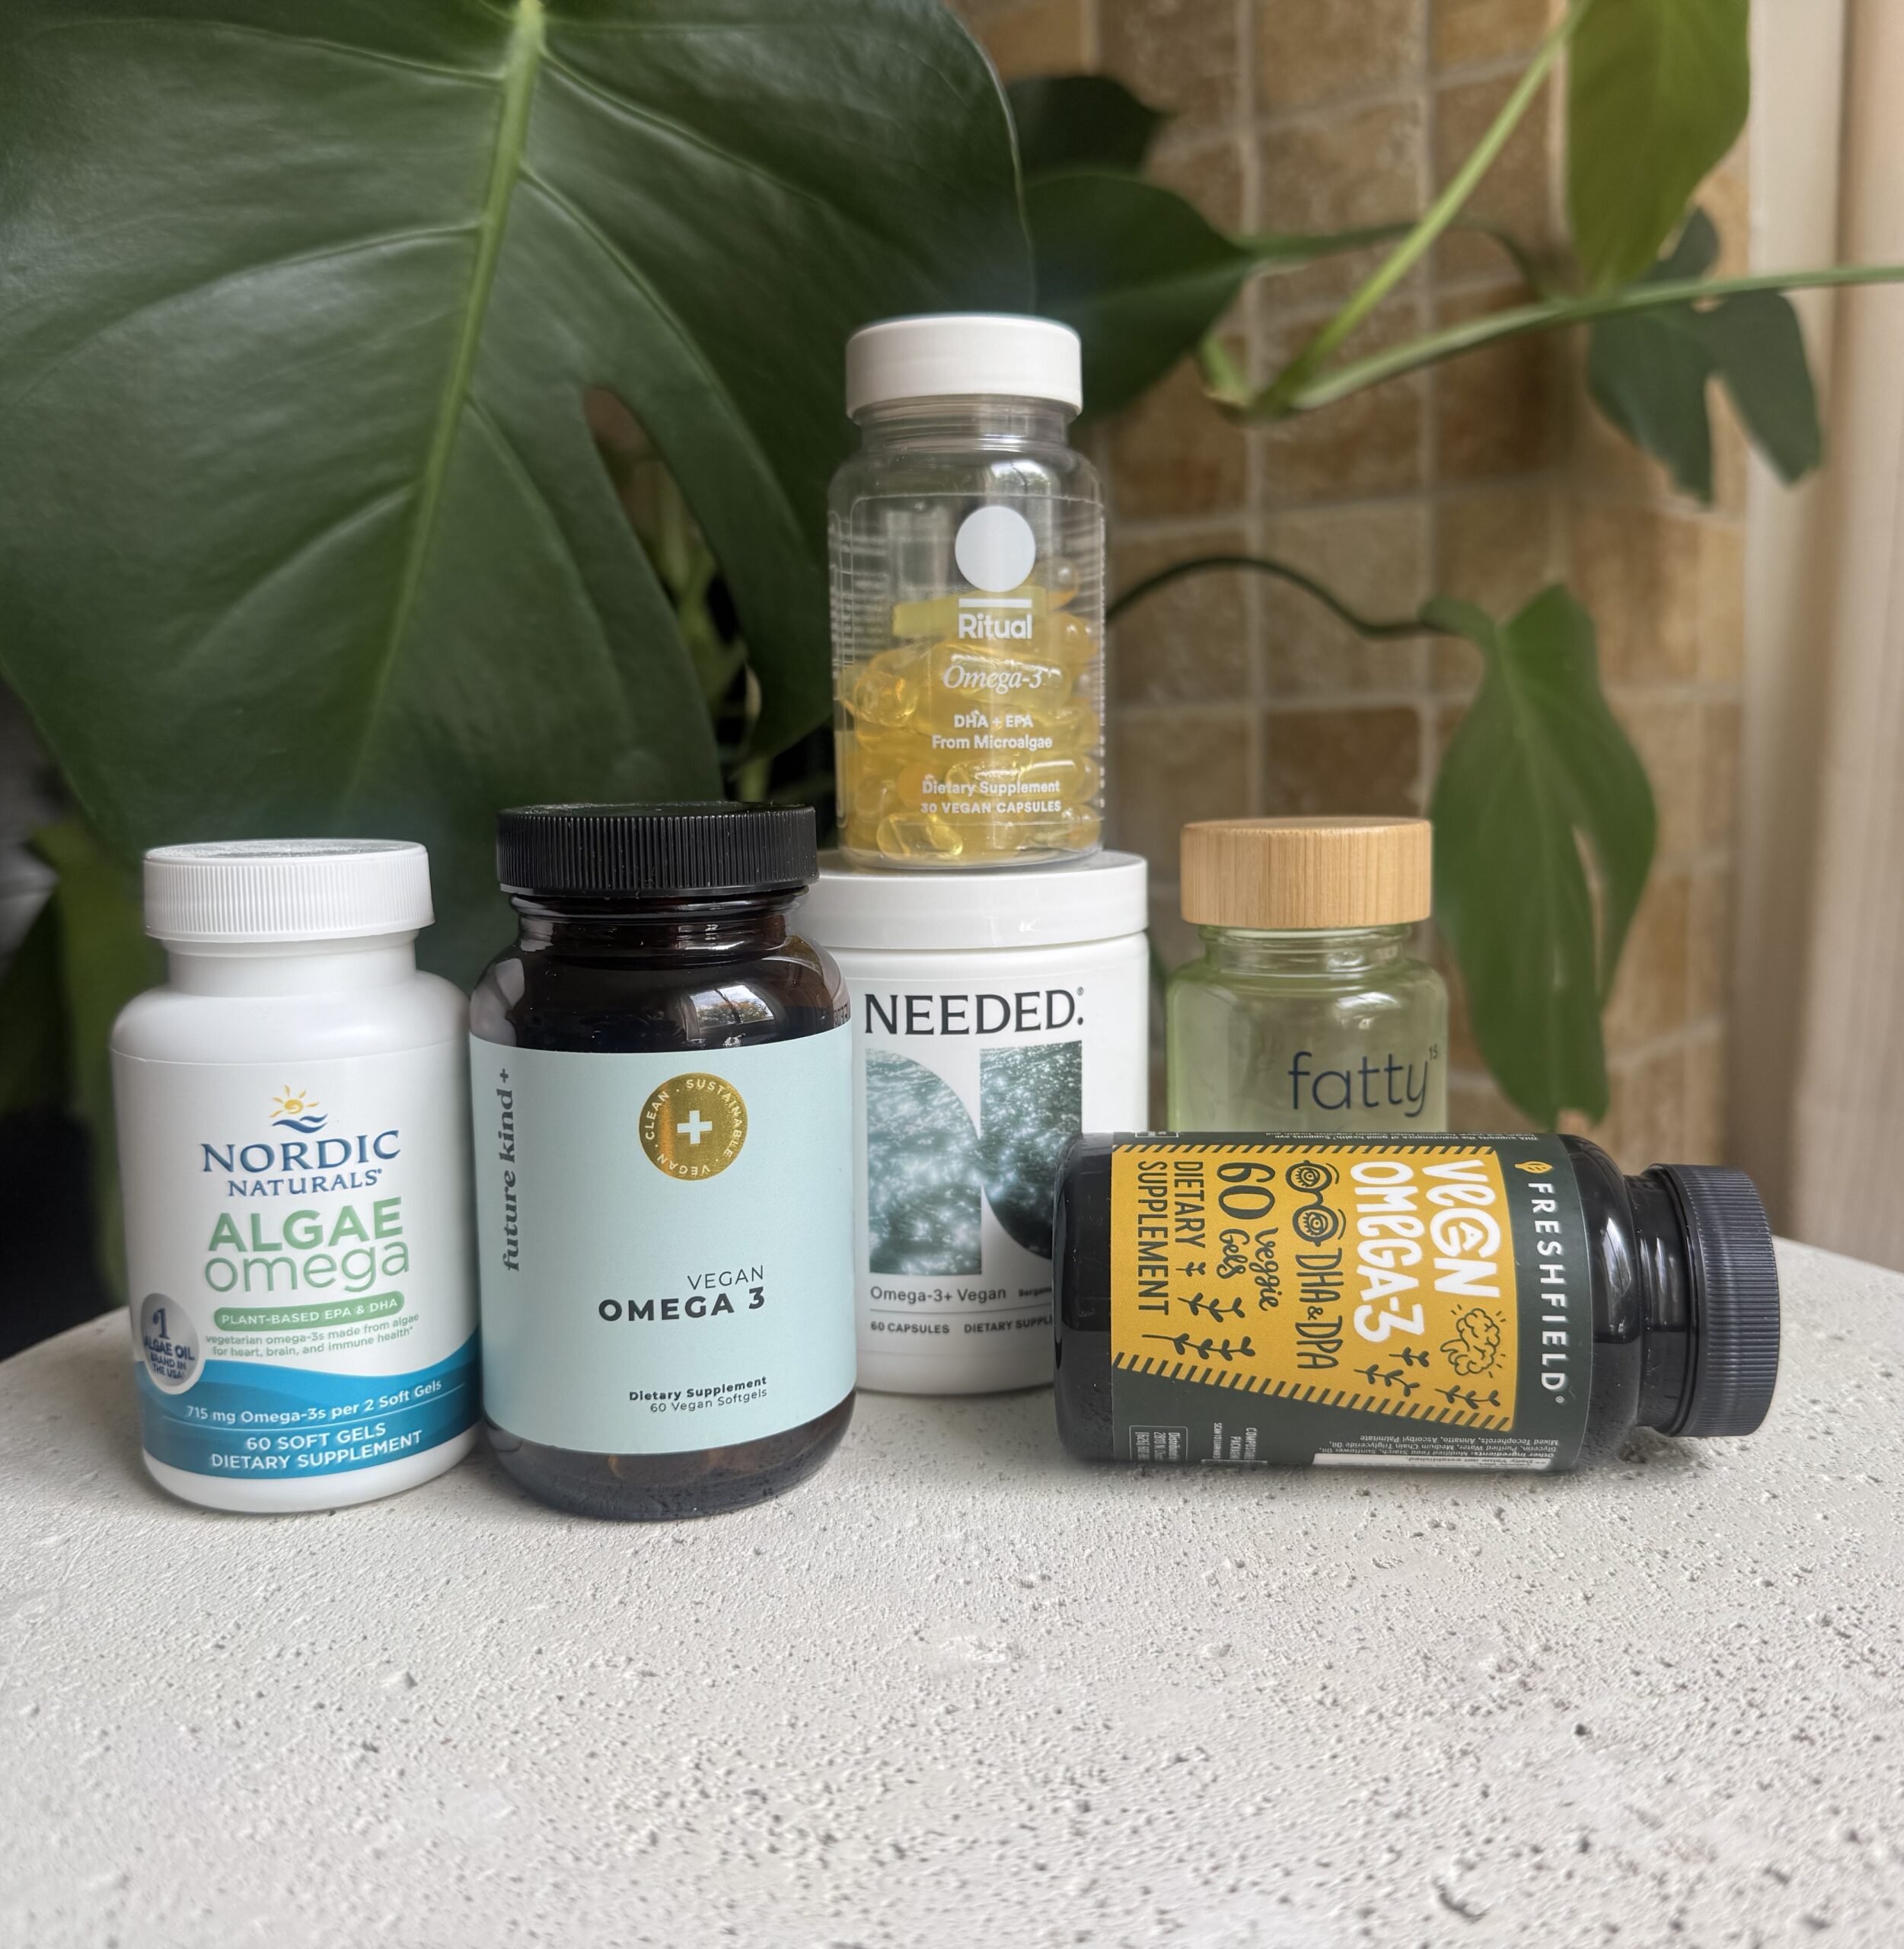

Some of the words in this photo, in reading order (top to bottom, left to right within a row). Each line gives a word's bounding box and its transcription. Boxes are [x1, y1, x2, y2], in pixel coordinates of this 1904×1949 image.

[958, 613, 1032, 640] Ritual
[942, 665, 1043, 694] Omega-3
[954, 714, 988, 728] DHA
[1005, 714, 1034, 728] EPA
[932, 735, 970, 748] From
[974, 735, 1052, 751] Microalgae
[922, 779, 975, 796] Dietary
[979, 779, 1060, 796] Supplement
[920, 802, 937, 813] 30
[942, 802, 990, 813] VEGAN
[996, 801, 1061, 813] CAPSULES
[1288, 1051, 1427, 1118] fatty
[496, 1089, 515, 1163] kind
[645, 1090, 669, 1140] CLEAN
[685, 1079, 743, 1158] SUSTAINABLE
[200, 1130, 401, 1173] NORDIC
[657, 1153, 711, 1175] VEGAN
[1174, 1161, 1205, 1248] DIETARY
[1217, 1162, 1276, 1220] 60
[209, 1196, 403, 1252] ALGAE
[502, 1169, 519, 1271] future
[1137, 1160, 1169, 1315] SUPPLEMENT
[205, 1241, 409, 1293] omega
[687, 1265, 763, 1290] VEGAN
[1295, 1247, 1344, 1303] DHA
[598, 1293, 735, 1322] OMEGA
[748, 1286, 765, 1309] 3
[870, 1286, 952, 1303] Omega-3+
[957, 1285, 1006, 1303] Vegan
[222, 1311, 320, 1325] PLANT-BASED
[325, 1307, 352, 1321] EPA
[356, 1305, 365, 1316] &
[370, 1299, 398, 1313] DHA
[870, 1321, 885, 1331] 60
[888, 1322, 949, 1334] CAPSULES
[964, 1320, 1013, 1333] DIETARY
[1307, 1306, 1323, 1320] &
[206, 1334, 263, 1346] vegetarian
[266, 1332, 324, 1345] omega-3s
[328, 1327, 360, 1340] made
[362, 1322, 390, 1335] from
[393, 1313, 419, 1329] algae
[1295, 1315, 1343, 1369] DPA
[144, 1335, 173, 1357] ALGAE
[174, 1345, 196, 1360] OIL
[212, 1346, 228, 1356] for
[231, 1346, 263, 1357] heart,
[266, 1346, 299, 1357] brain,
[302, 1343, 325, 1354] and
[328, 1337, 375, 1352] immune
[187, 1405, 208, 1420] 715
[213, 1411, 236, 1424] mg
[241, 1408, 327, 1425] Omega-3s
[331, 1403, 359, 1420] per
[365, 1399, 375, 1412] 2
[380, 1391, 410, 1408] Soft
[414, 1380, 442, 1397] Gels
[629, 1390, 681, 1402] Dietary
[686, 1376, 767, 1398] Supplement
[650, 1402, 666, 1413] 60
[671, 1399, 713, 1412] Vegan
[717, 1389, 767, 1406] Softgels
[211, 1453, 292, 1469] DIETARY
[297, 1429, 423, 1469] SUPPLEMENT
[246, 1437, 272, 1451] 60
[278, 1432, 331, 1450] SOFT
[336, 1422, 387, 1444] GELS
